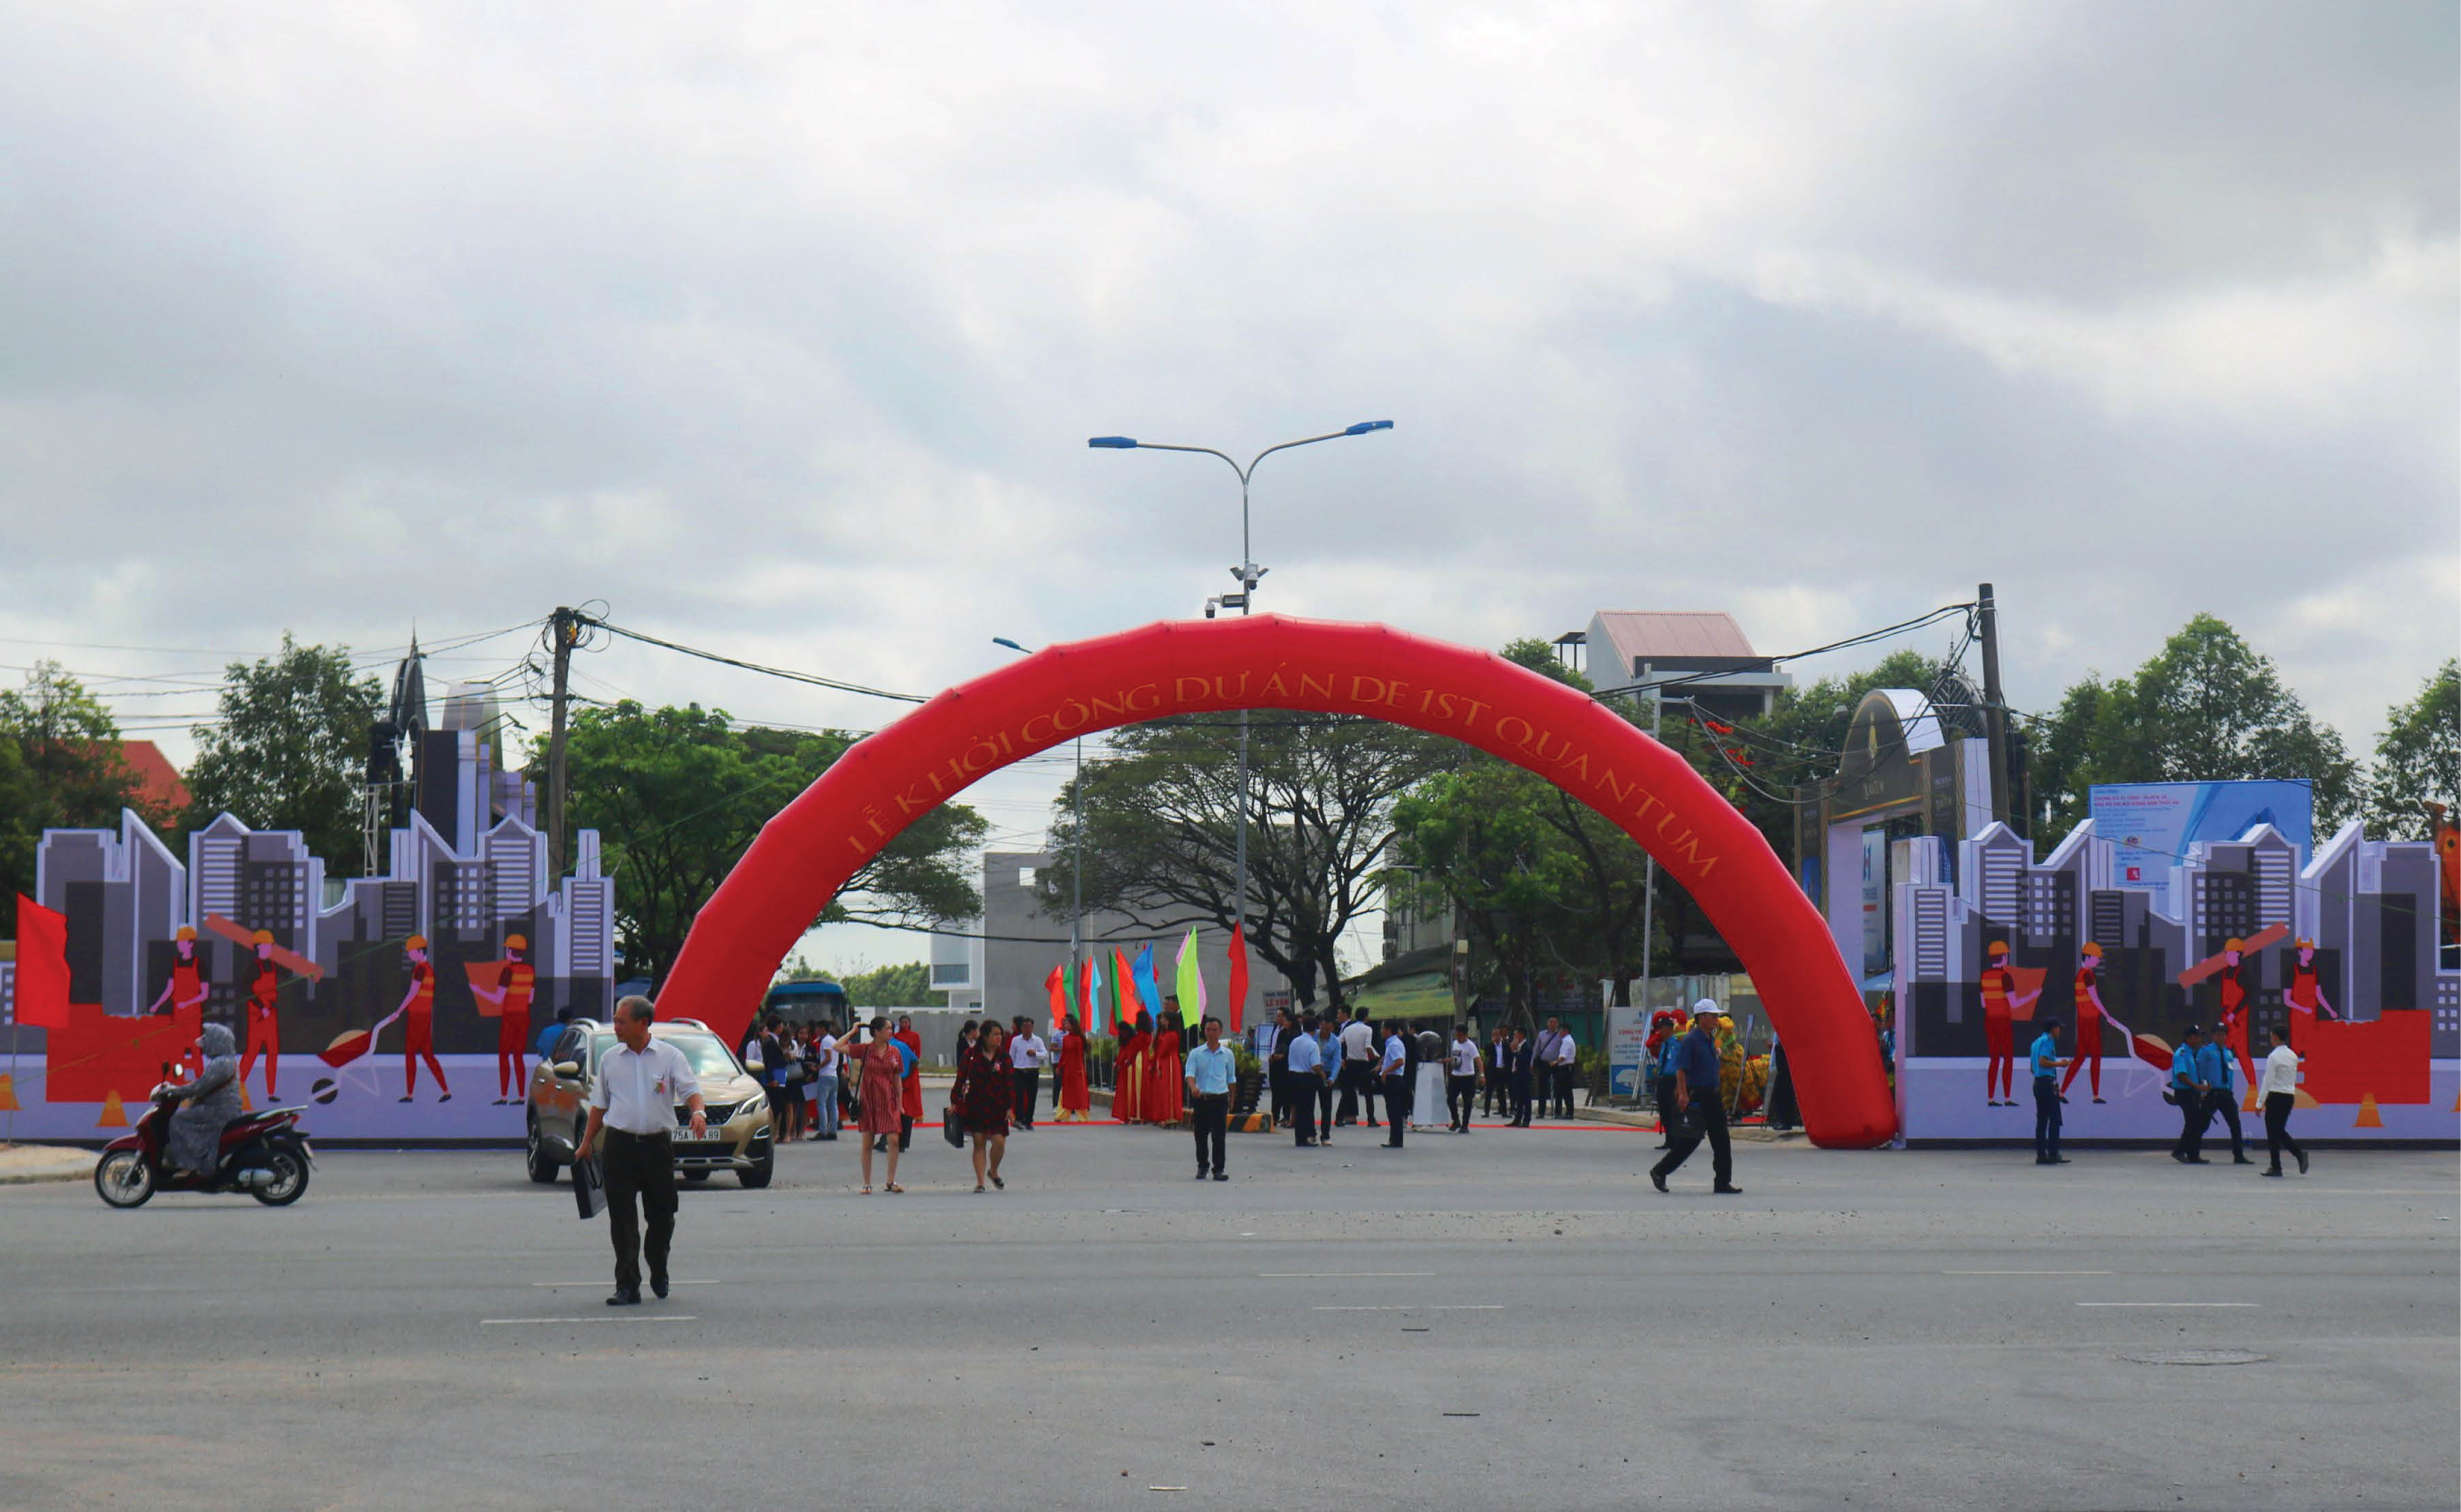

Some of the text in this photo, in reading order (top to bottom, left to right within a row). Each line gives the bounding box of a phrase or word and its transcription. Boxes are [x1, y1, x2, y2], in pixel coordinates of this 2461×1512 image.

[1022, 683, 1159, 744] CÔNG
[1261, 662, 1334, 699] ÁN
[1350, 675, 1409, 709] DE
[1420, 688, 1492, 727] 1ST
[1494, 715, 1719, 878] QUANTUM
